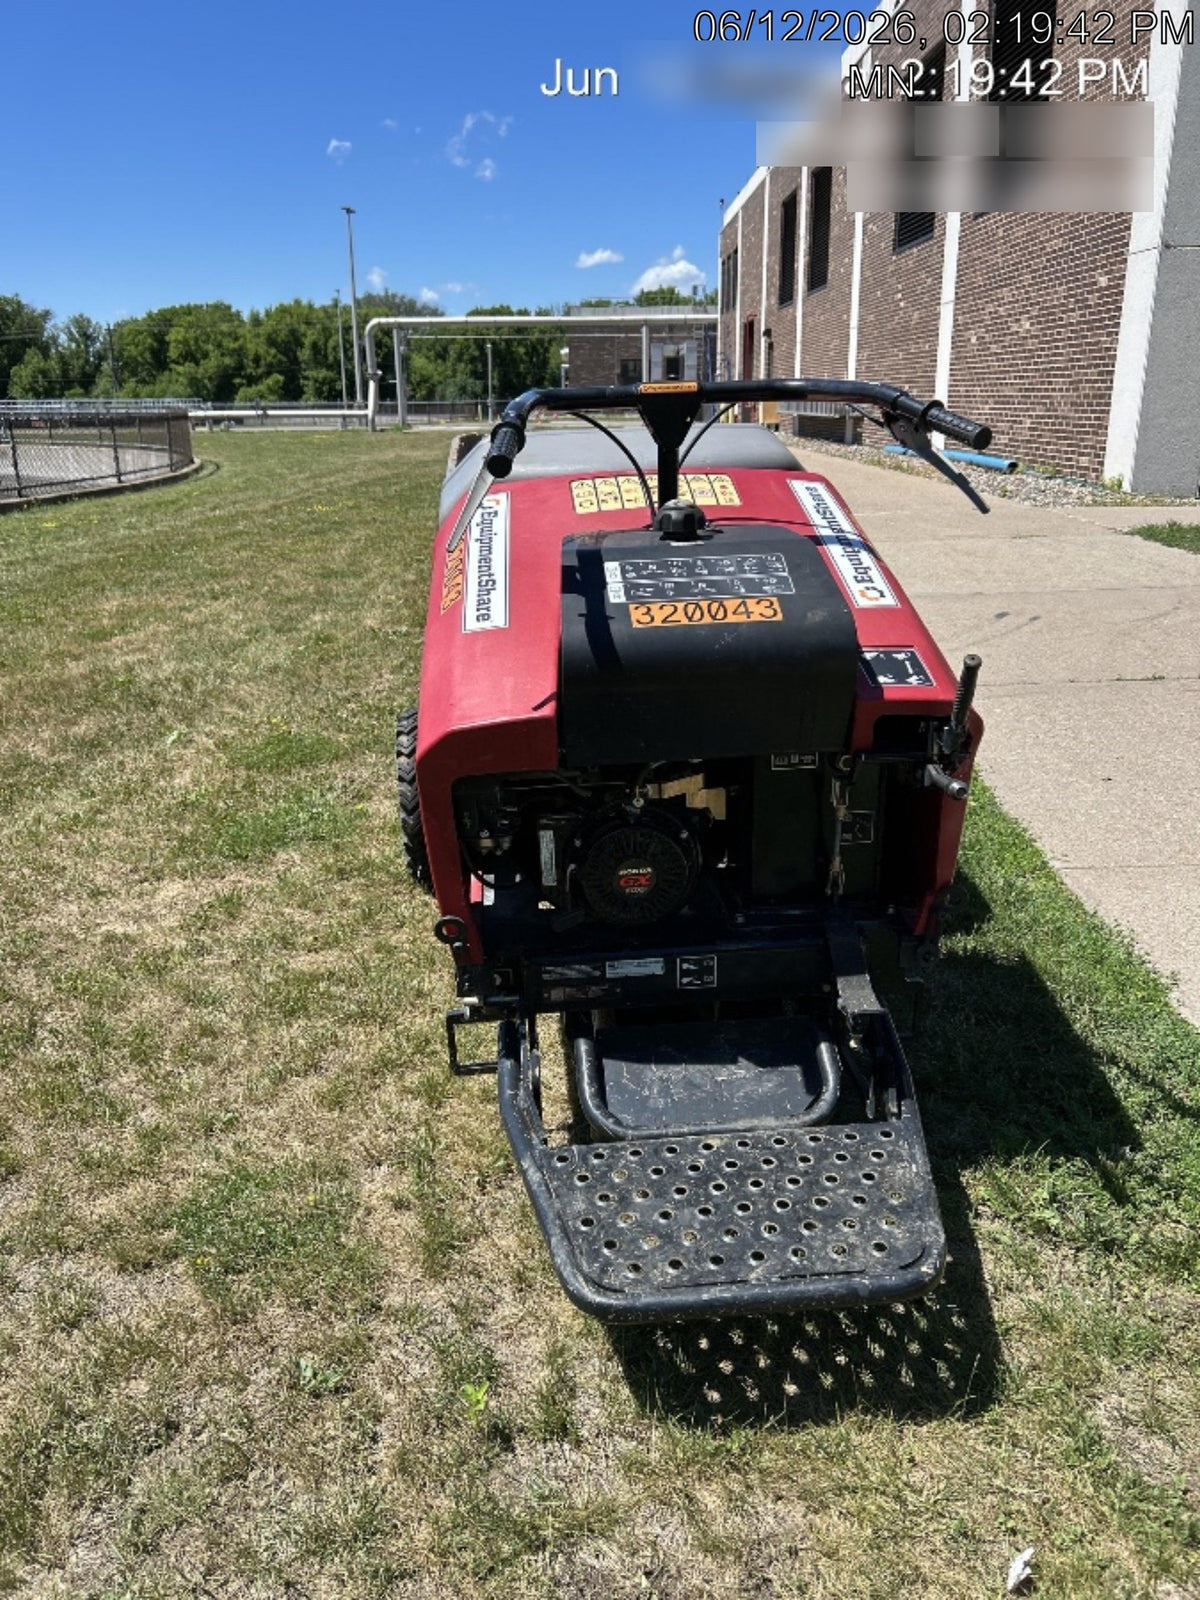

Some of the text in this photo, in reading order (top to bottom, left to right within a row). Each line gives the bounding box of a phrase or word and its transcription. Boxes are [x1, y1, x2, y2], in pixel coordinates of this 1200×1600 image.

[475, 509, 499, 623] EquipmentShare
[804, 486, 875, 584] EquipmentShare
[634, 598, 778, 625] 320043
